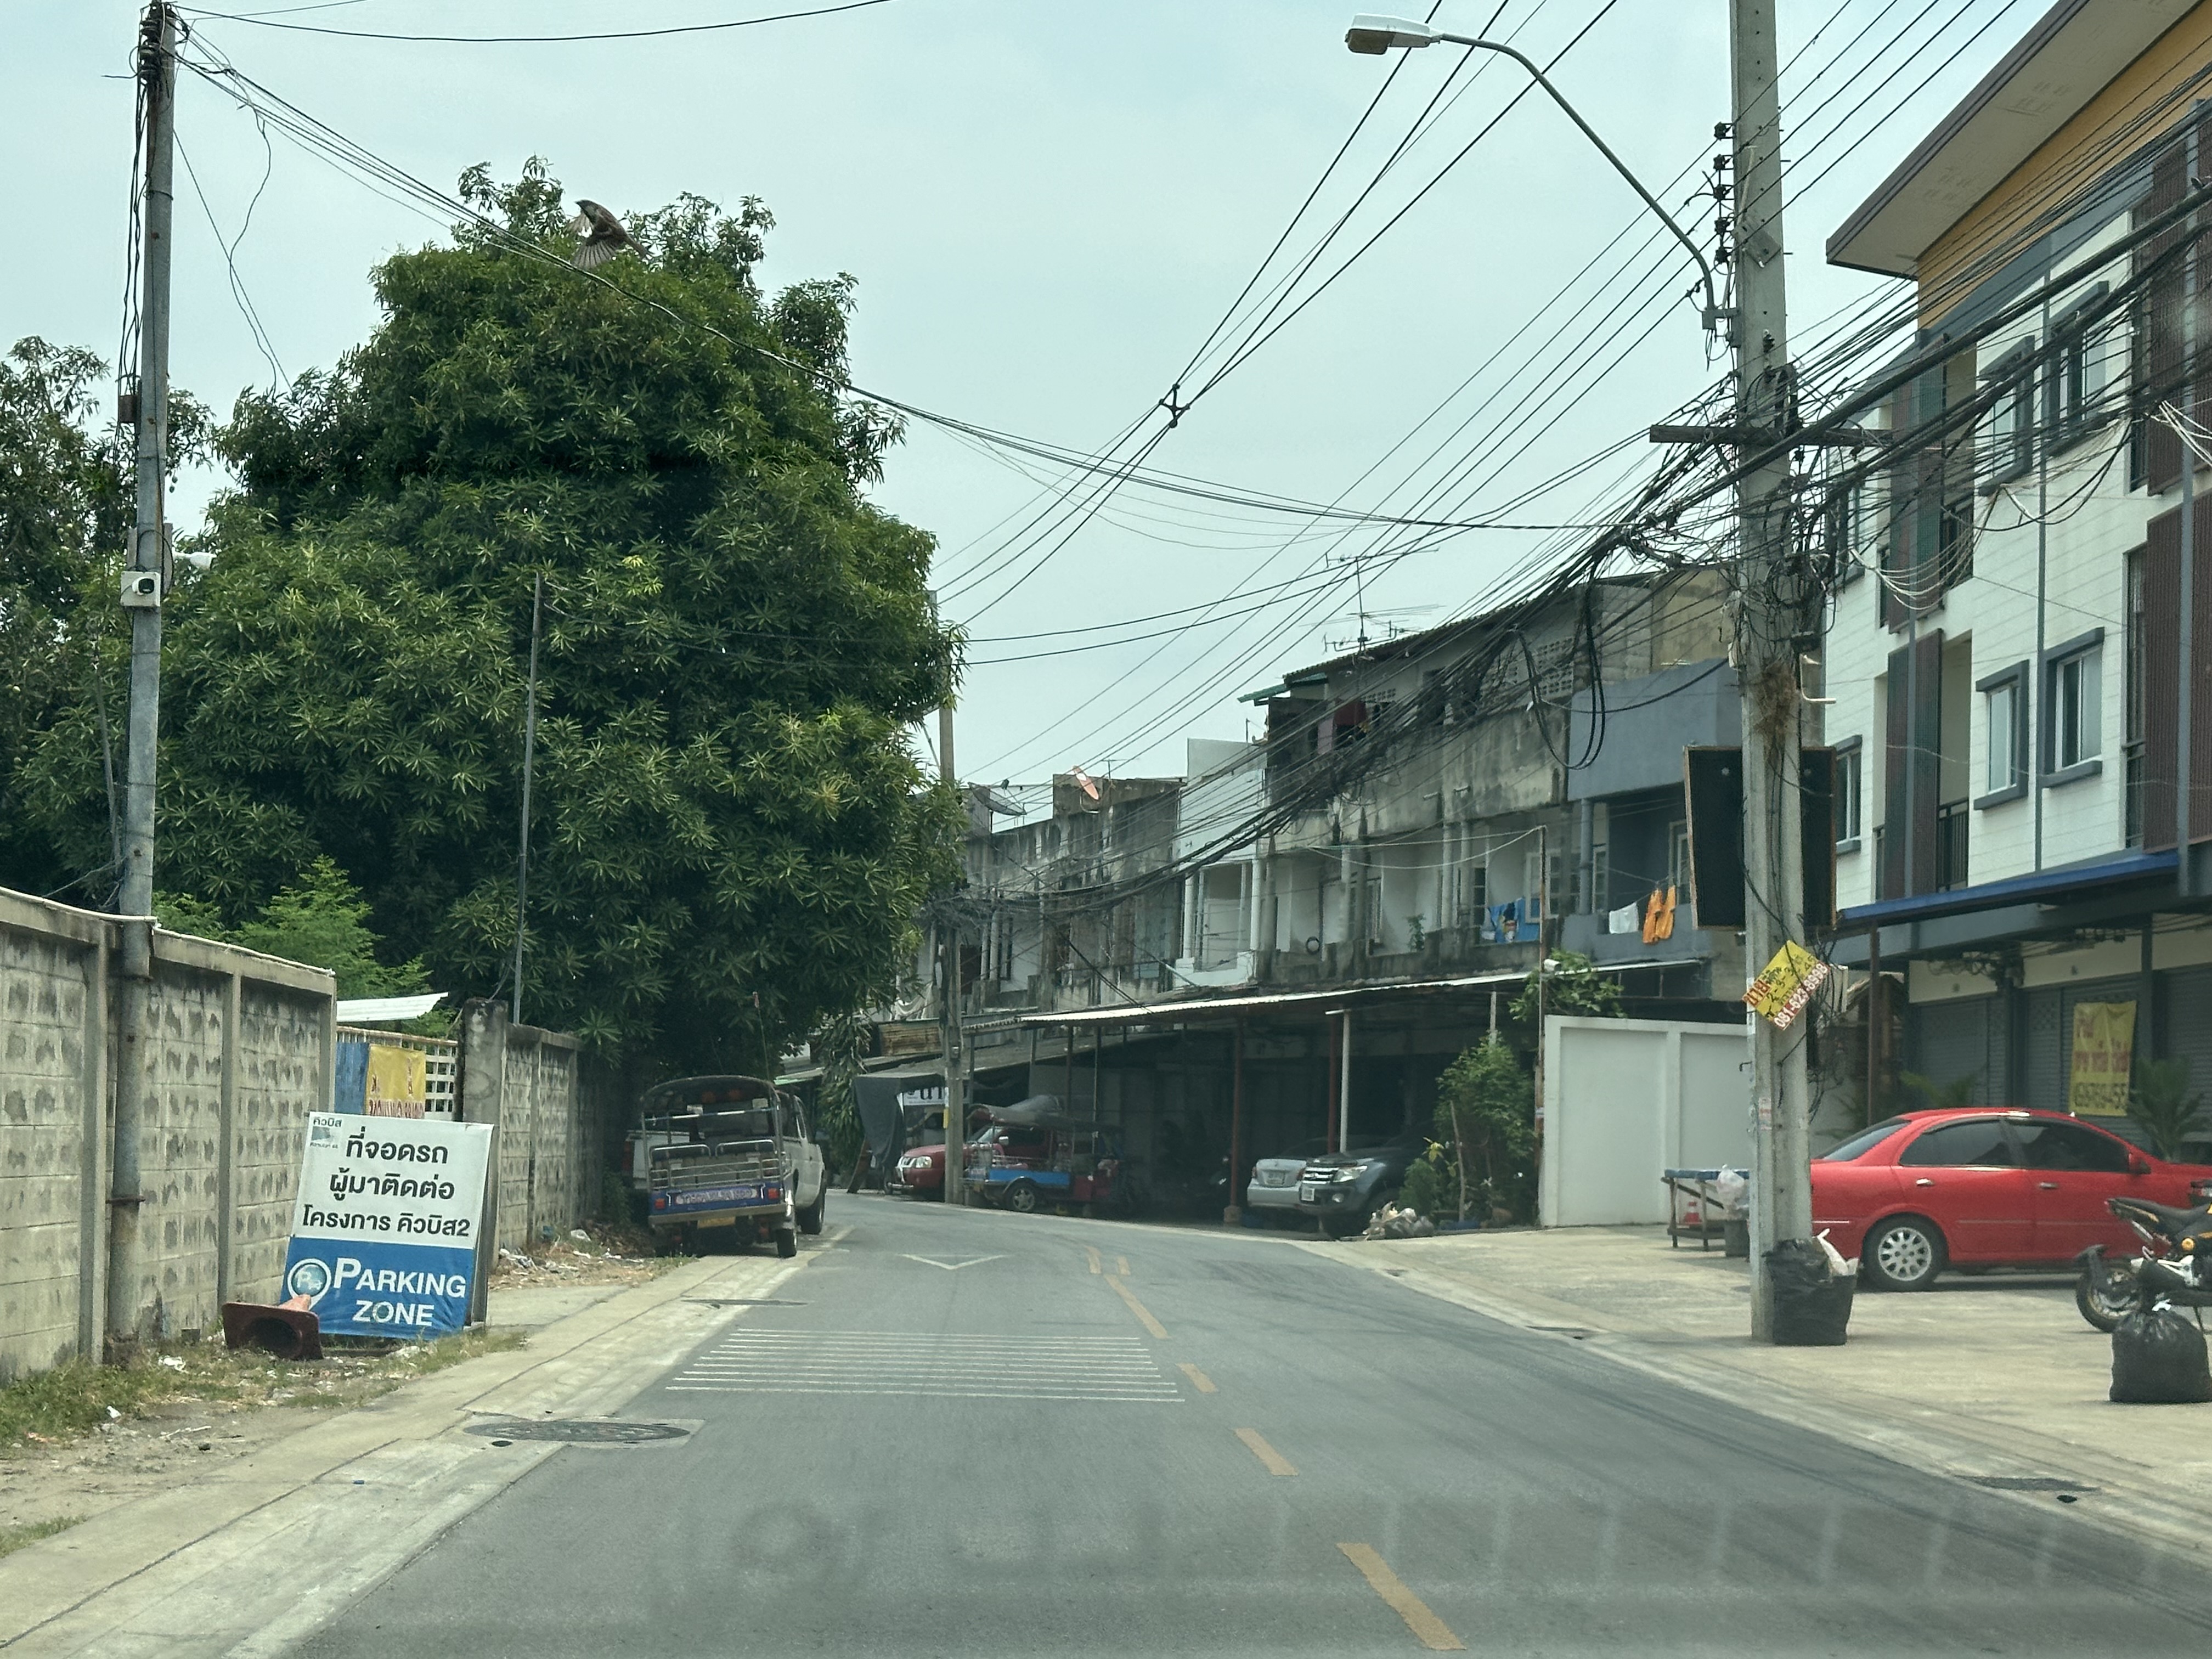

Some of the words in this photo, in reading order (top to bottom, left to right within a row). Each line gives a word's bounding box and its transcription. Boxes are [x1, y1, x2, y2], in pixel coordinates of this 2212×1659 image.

[346, 1126, 448, 1164] ที่จอดรถ
[329, 1166, 455, 1201] ผู้มาติดต่อ
[302, 1204, 391, 1231] โครงการ
[397, 1212, 471, 1237] คิวบิส2
[333, 1257, 466, 1299] PARKING
[352, 1300, 435, 1327] ZONE
